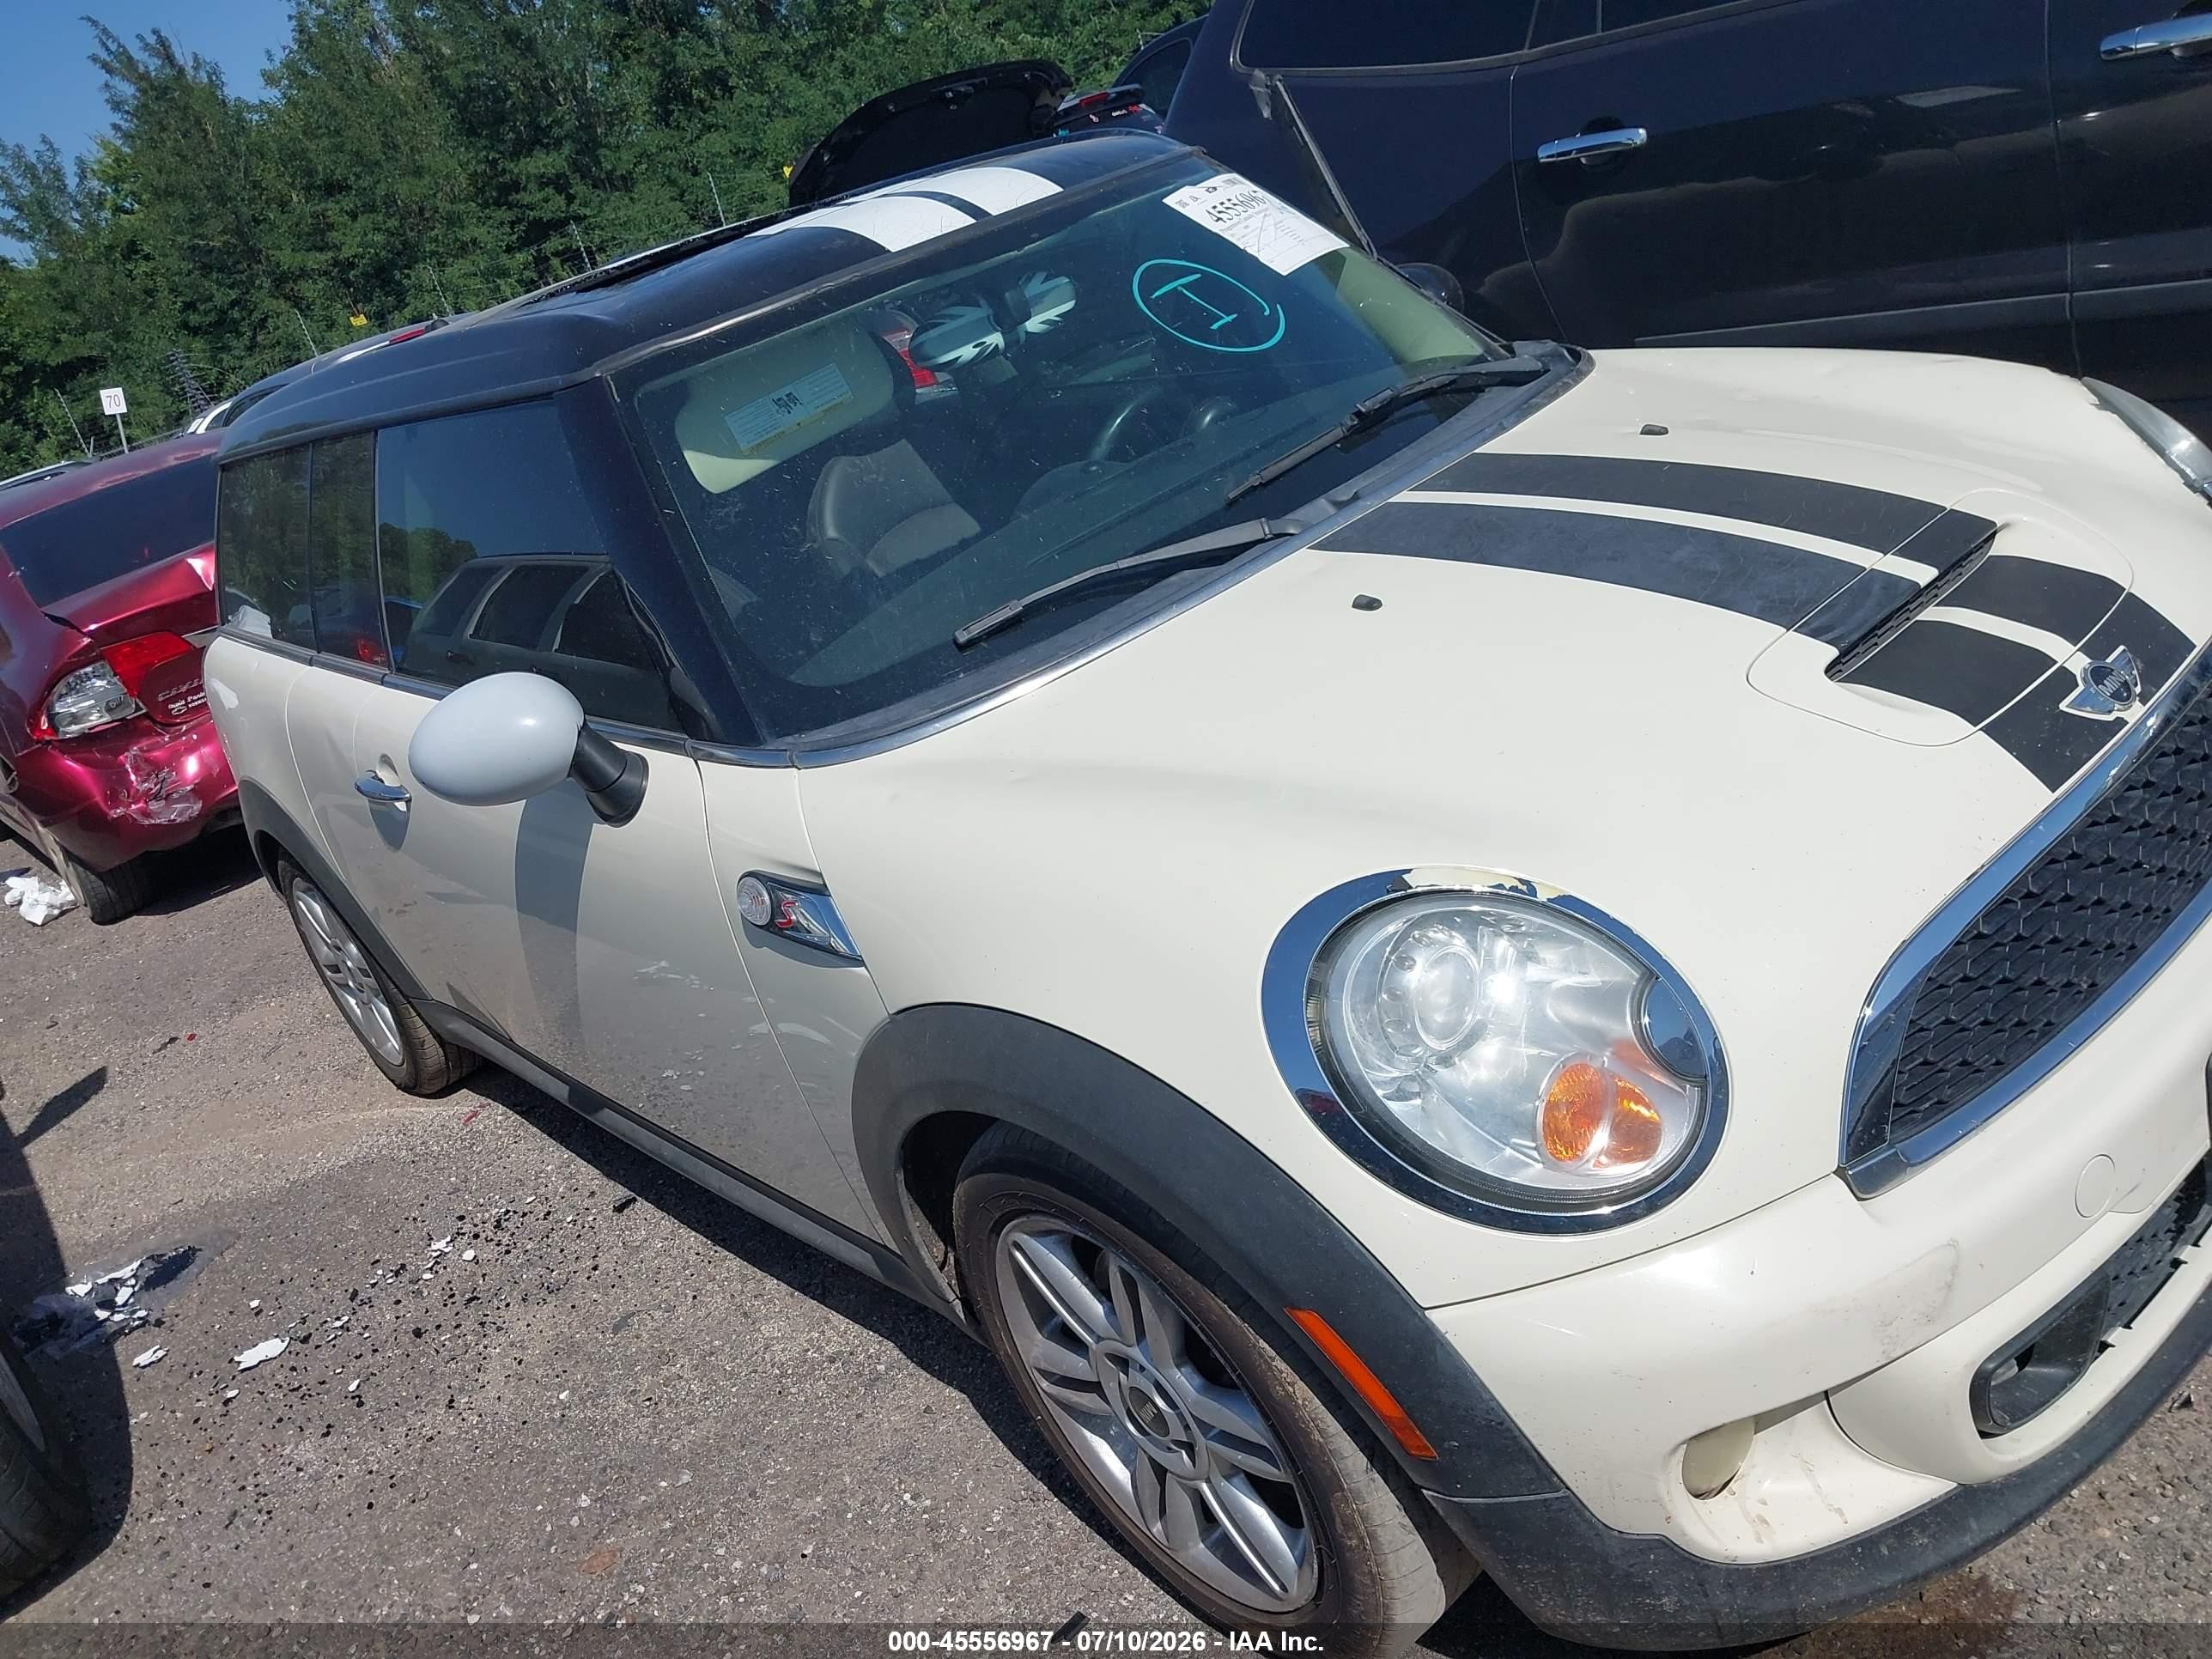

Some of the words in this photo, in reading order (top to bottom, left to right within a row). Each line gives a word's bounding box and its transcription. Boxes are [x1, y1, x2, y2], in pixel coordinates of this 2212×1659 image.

[105, 393, 121, 409] 70
[2098, 670, 2126, 696] MINI
[775, 900, 799, 929] S
